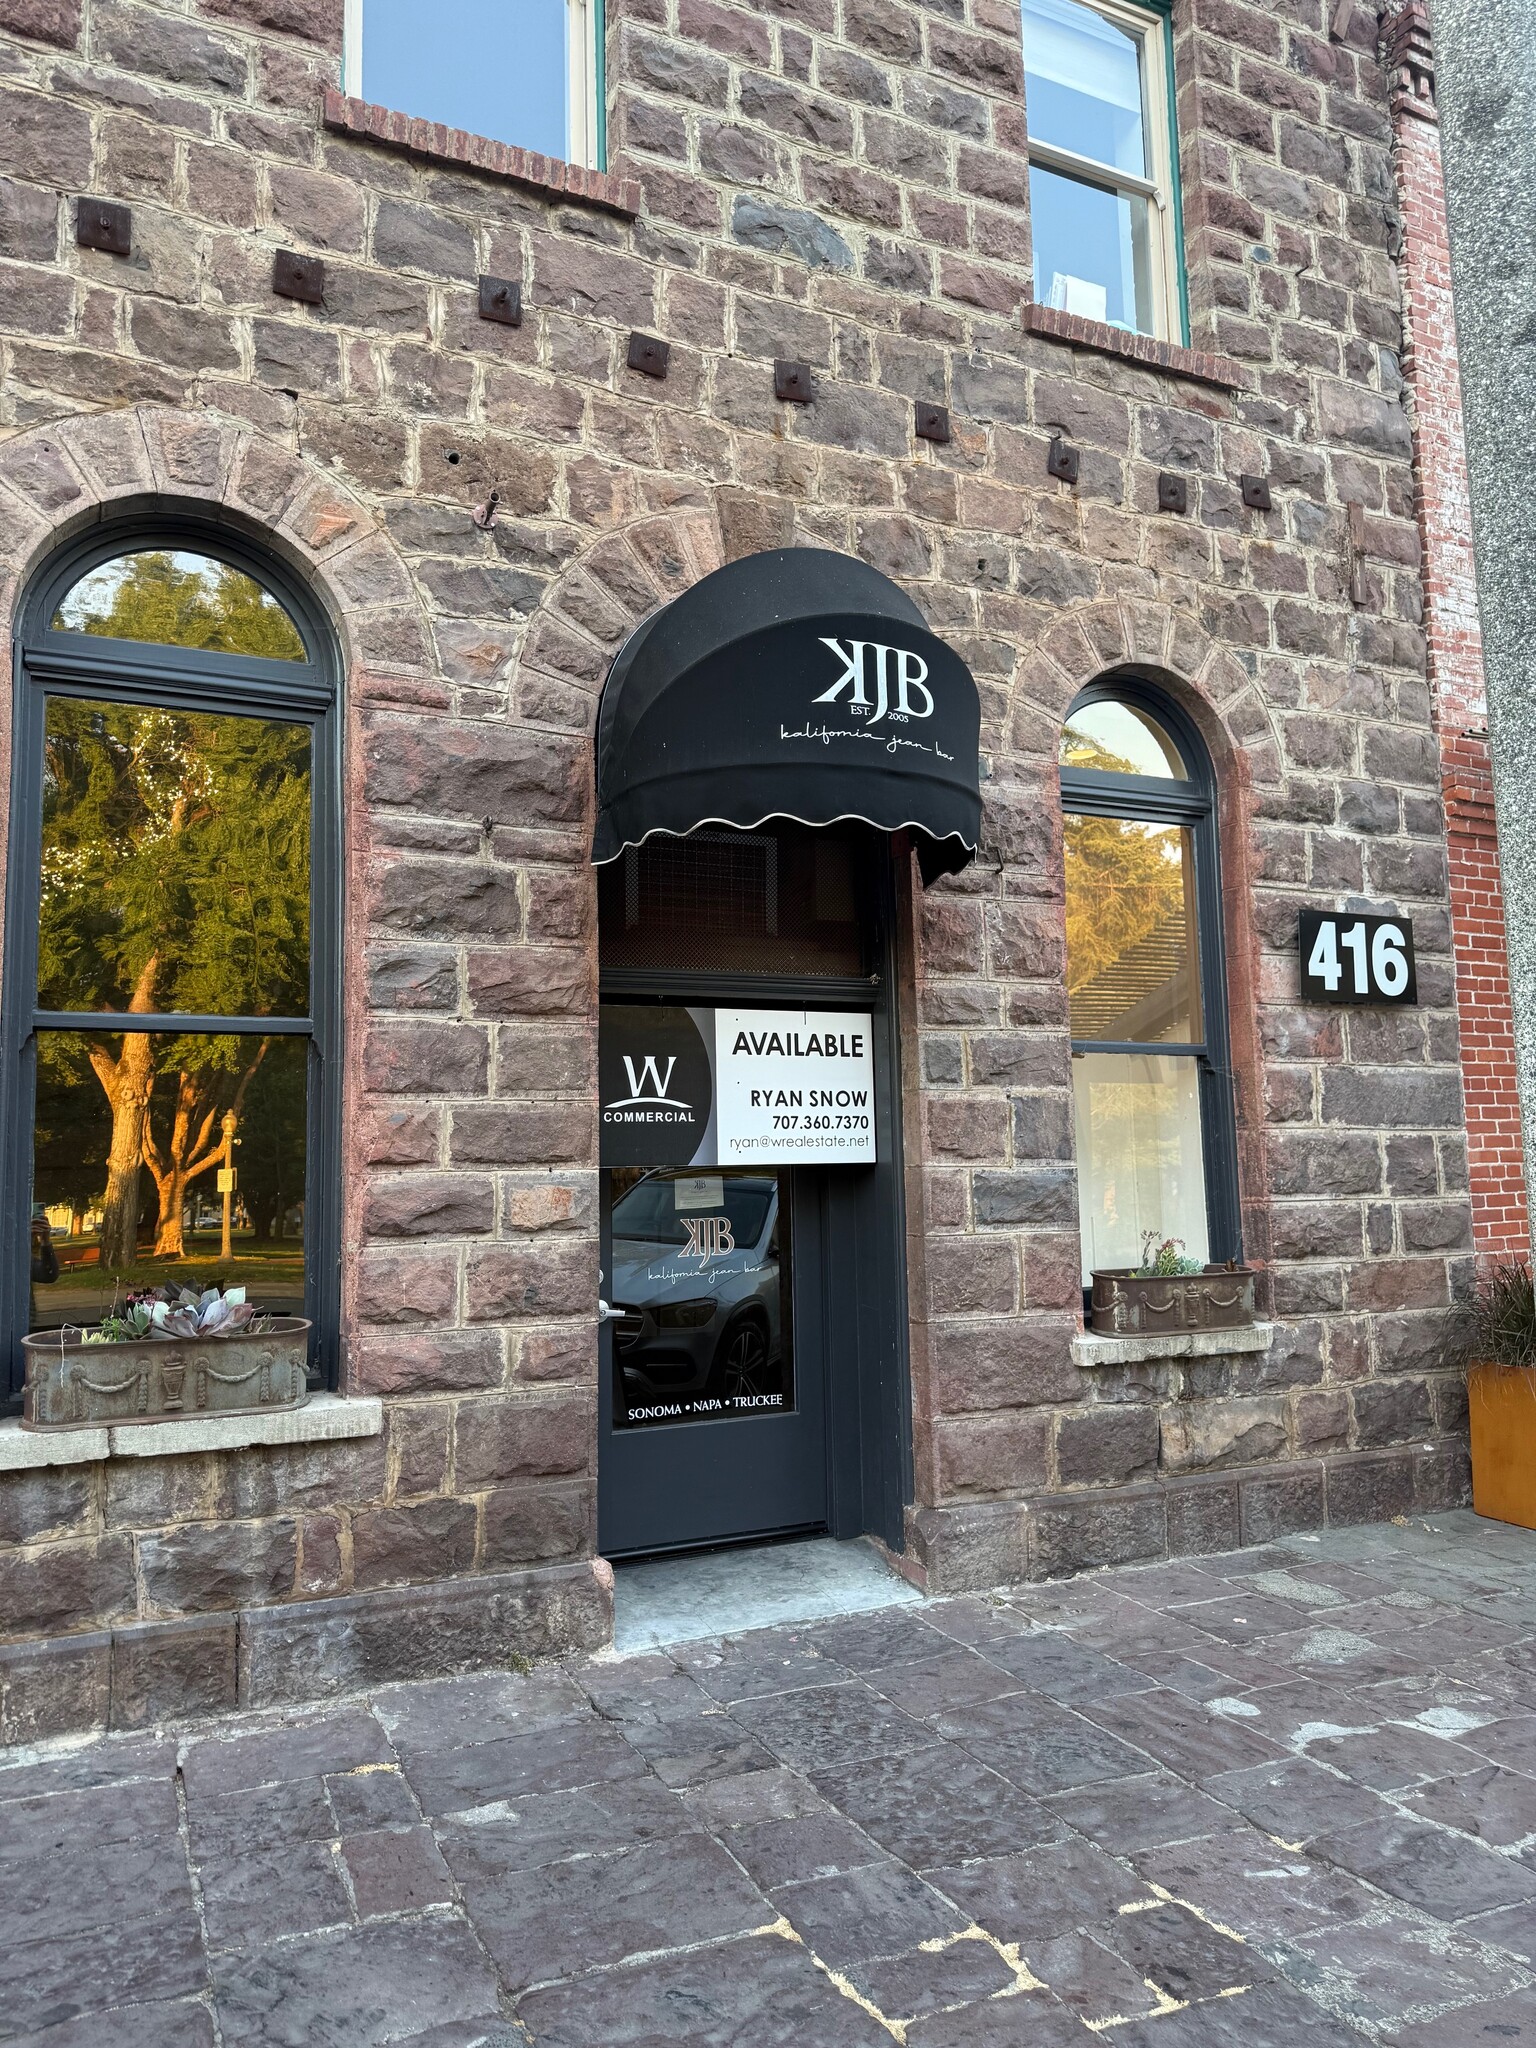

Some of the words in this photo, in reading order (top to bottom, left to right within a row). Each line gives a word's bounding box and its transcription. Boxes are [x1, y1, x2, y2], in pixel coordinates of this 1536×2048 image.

[811, 637, 935, 725] KJB
[850, 704, 871, 717] EST.
[887, 711, 909, 723] 2005
[780, 721, 886, 744] kalifornia
[886, 735, 933, 753] jean
[935, 741, 955, 762] bar
[1308, 920, 1409, 997] 416
[732, 1031, 864, 1058] AVAILABLE
[623, 1055, 677, 1098] W
[750, 1090, 803, 1107] RYAN
[809, 1090, 868, 1107] SNOW
[603, 1111, 696, 1123] COMMERCIAL
[772, 1115, 869, 1130] 707.360.7370
[730, 1135, 870, 1151] ryan@wrealestate.net
[677, 1216, 735, 1268] KJB
[647, 1266, 708, 1285] kalifornia
[708, 1267, 741, 1284] jean
[743, 1260, 763, 1273] bar
[628, 1404, 682, 1420] SONOMA
[693, 1398, 722, 1412] NAPA
[732, 1393, 783, 1408] TRUCKEE
